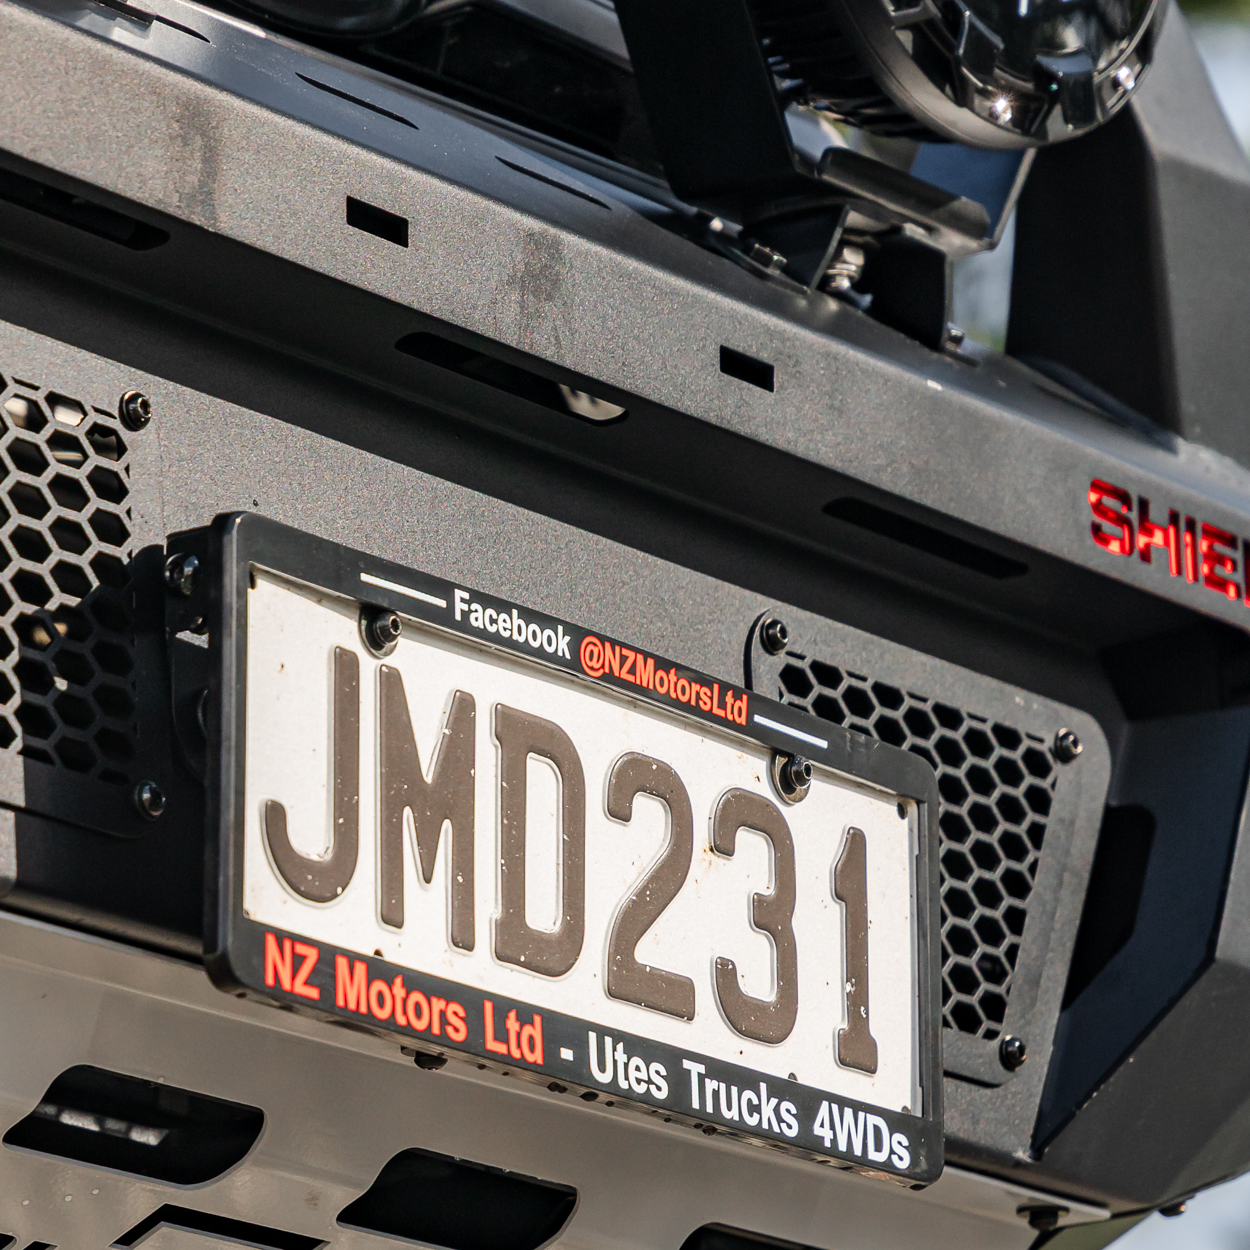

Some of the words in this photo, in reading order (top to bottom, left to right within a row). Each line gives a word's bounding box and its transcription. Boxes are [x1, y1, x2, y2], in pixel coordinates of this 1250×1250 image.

[1088, 478, 1250, 608] SHIE
[453, 588, 571, 660] Facebook
[579, 635, 748, 726] @NZMotorsLtd
[264, 645, 879, 1075] JMD231
[264, 932, 320, 1000] NZ
[335, 954, 468, 1043] Motors
[483, 999, 544, 1066] Ltd
[588, 1031, 669, 1100] Utes
[682, 1058, 799, 1138] Trucks
[813, 1100, 911, 1170] 4WDs
